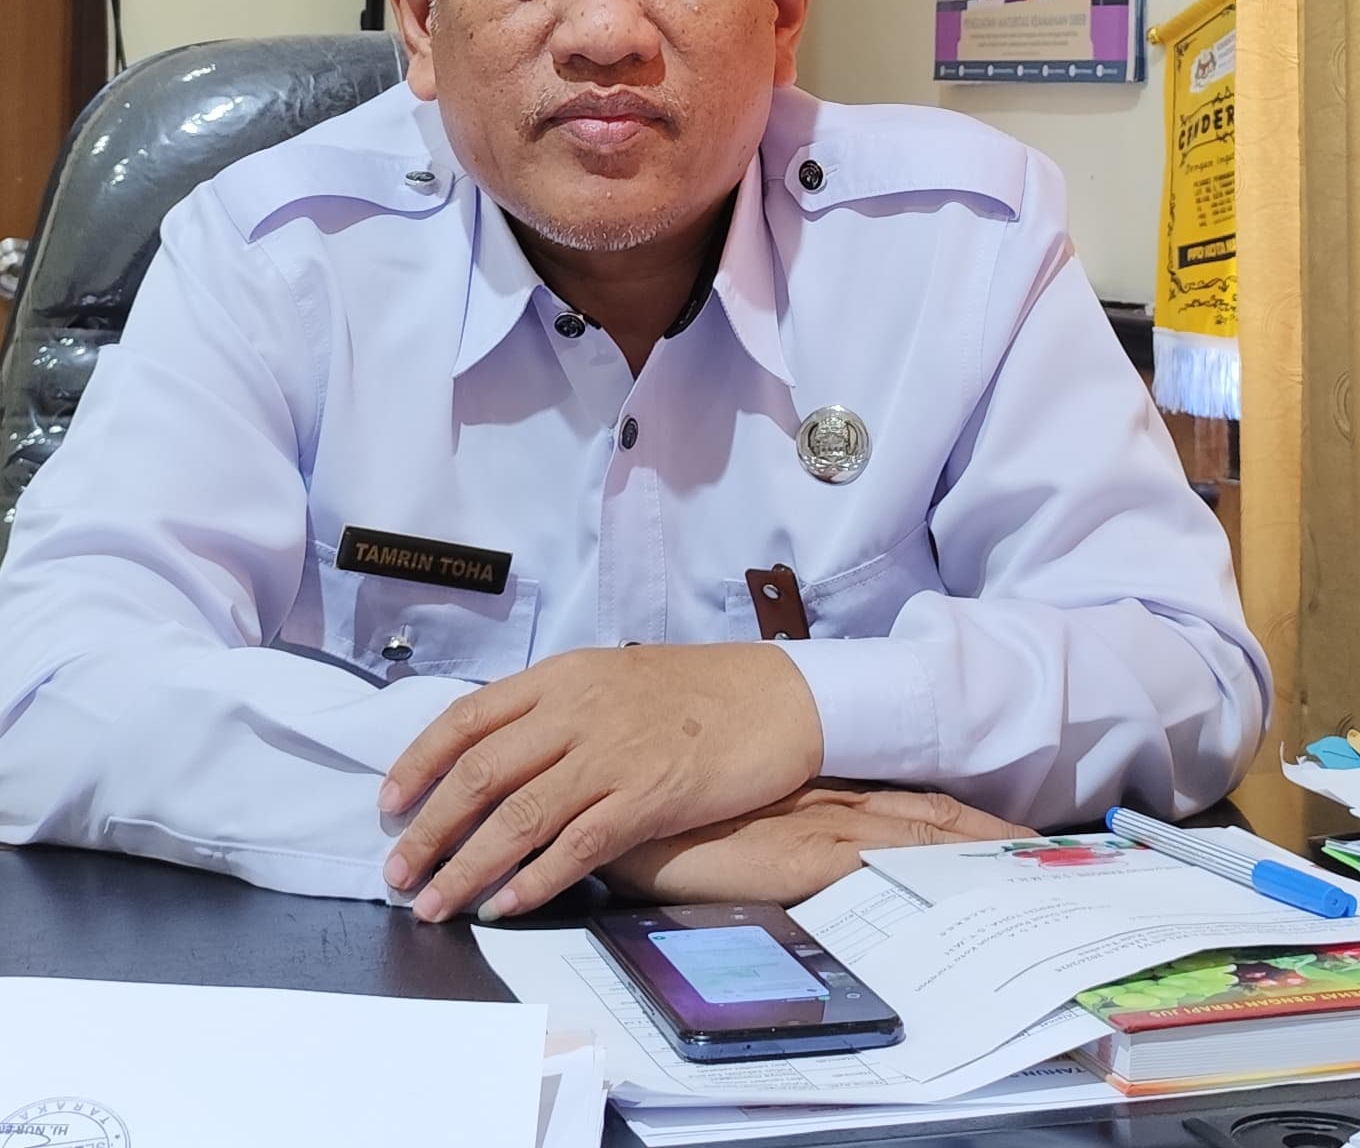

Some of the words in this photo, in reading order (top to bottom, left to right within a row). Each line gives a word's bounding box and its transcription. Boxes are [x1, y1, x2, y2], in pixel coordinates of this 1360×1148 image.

[355, 542, 434, 571] TAMRIN
[438, 556, 494, 581] TOHA
[1183, 1000, 1243, 1016] TERAPI
[1243, 993, 1316, 1009] DENGAN
[1149, 1007, 1180, 1019] JUS
[1023, 1067, 1087, 1078] TAHUN
